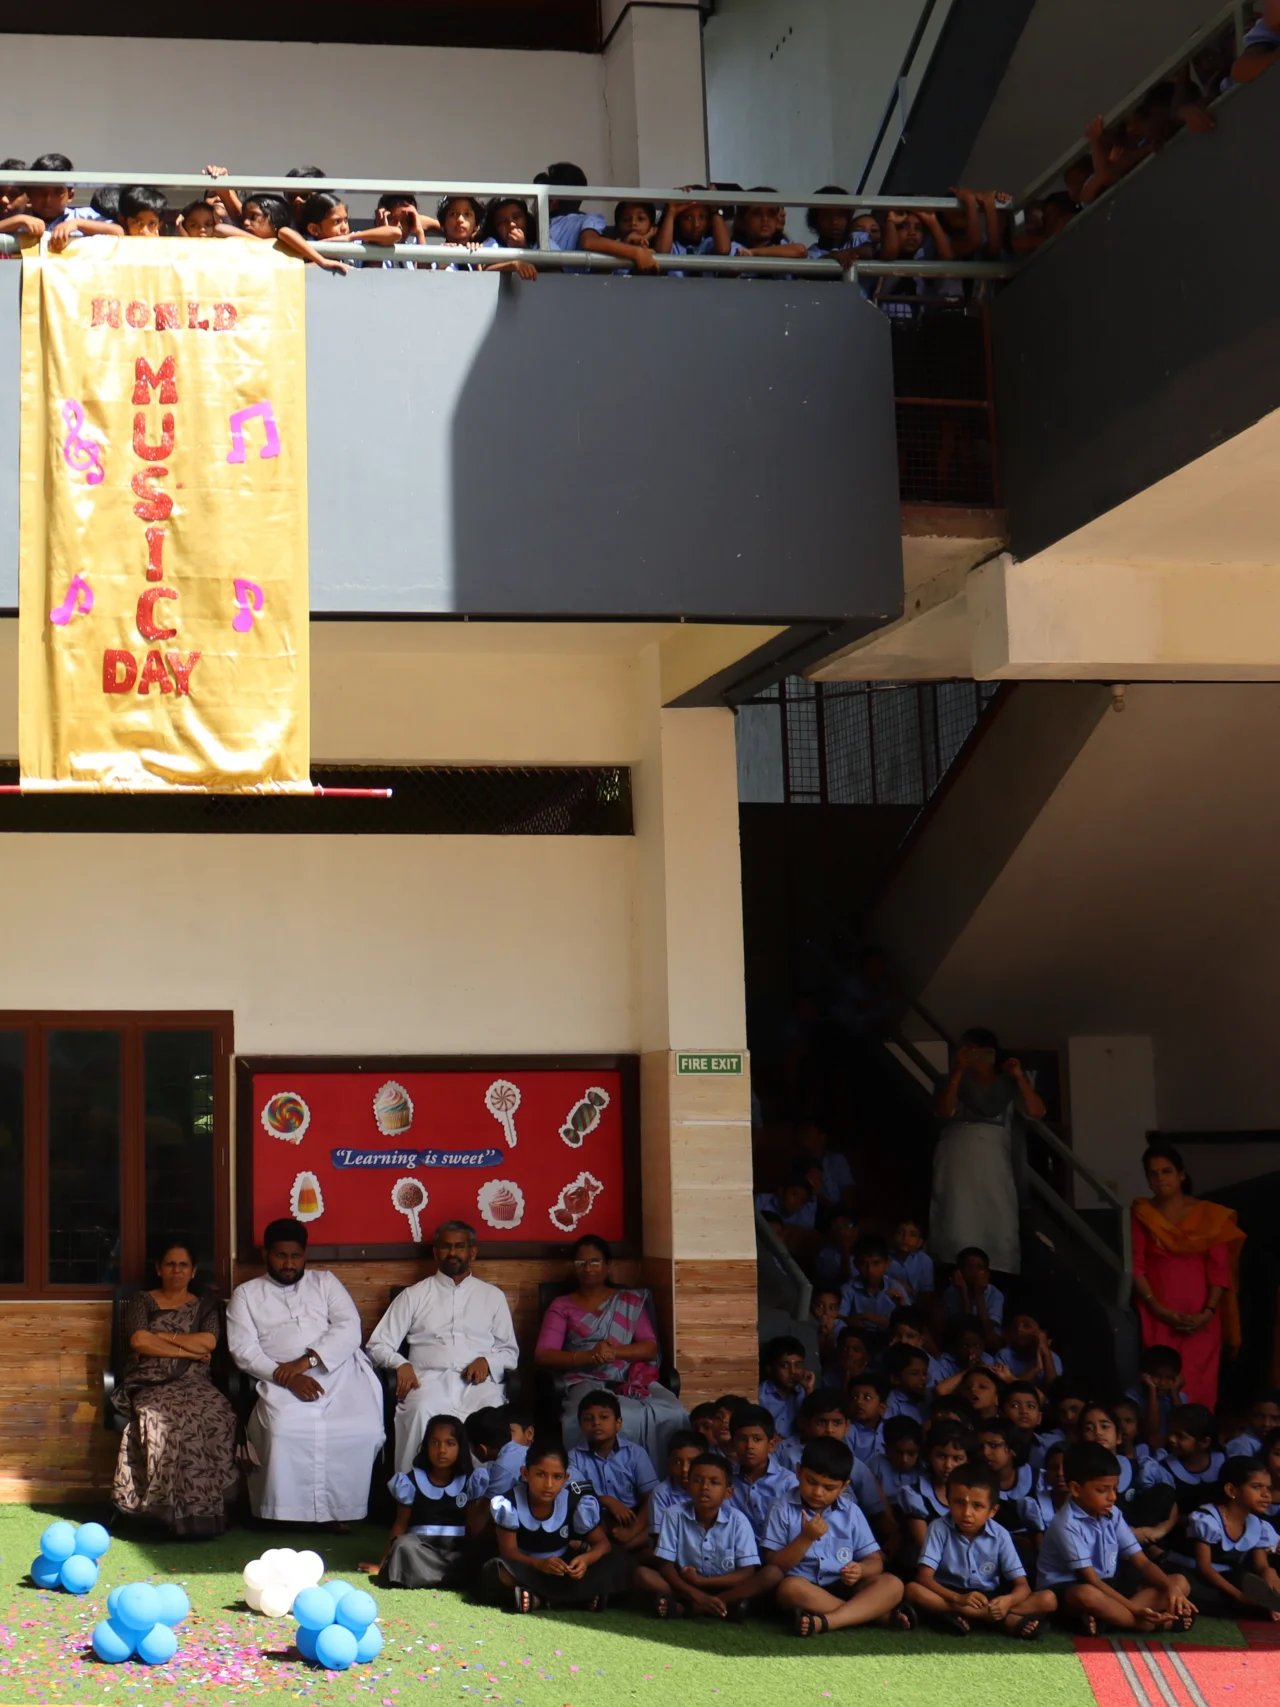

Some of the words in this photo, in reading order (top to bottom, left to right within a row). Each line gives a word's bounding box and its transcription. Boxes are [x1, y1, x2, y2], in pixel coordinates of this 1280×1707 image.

[91, 298, 238, 331] WORLD
[131, 355, 179, 640] MUSIC
[102, 648, 202, 696] DAY
[681, 1058, 708, 1070] FIRE
[711, 1058, 739, 1070] EXIT
[425, 1150, 438, 1165] is
